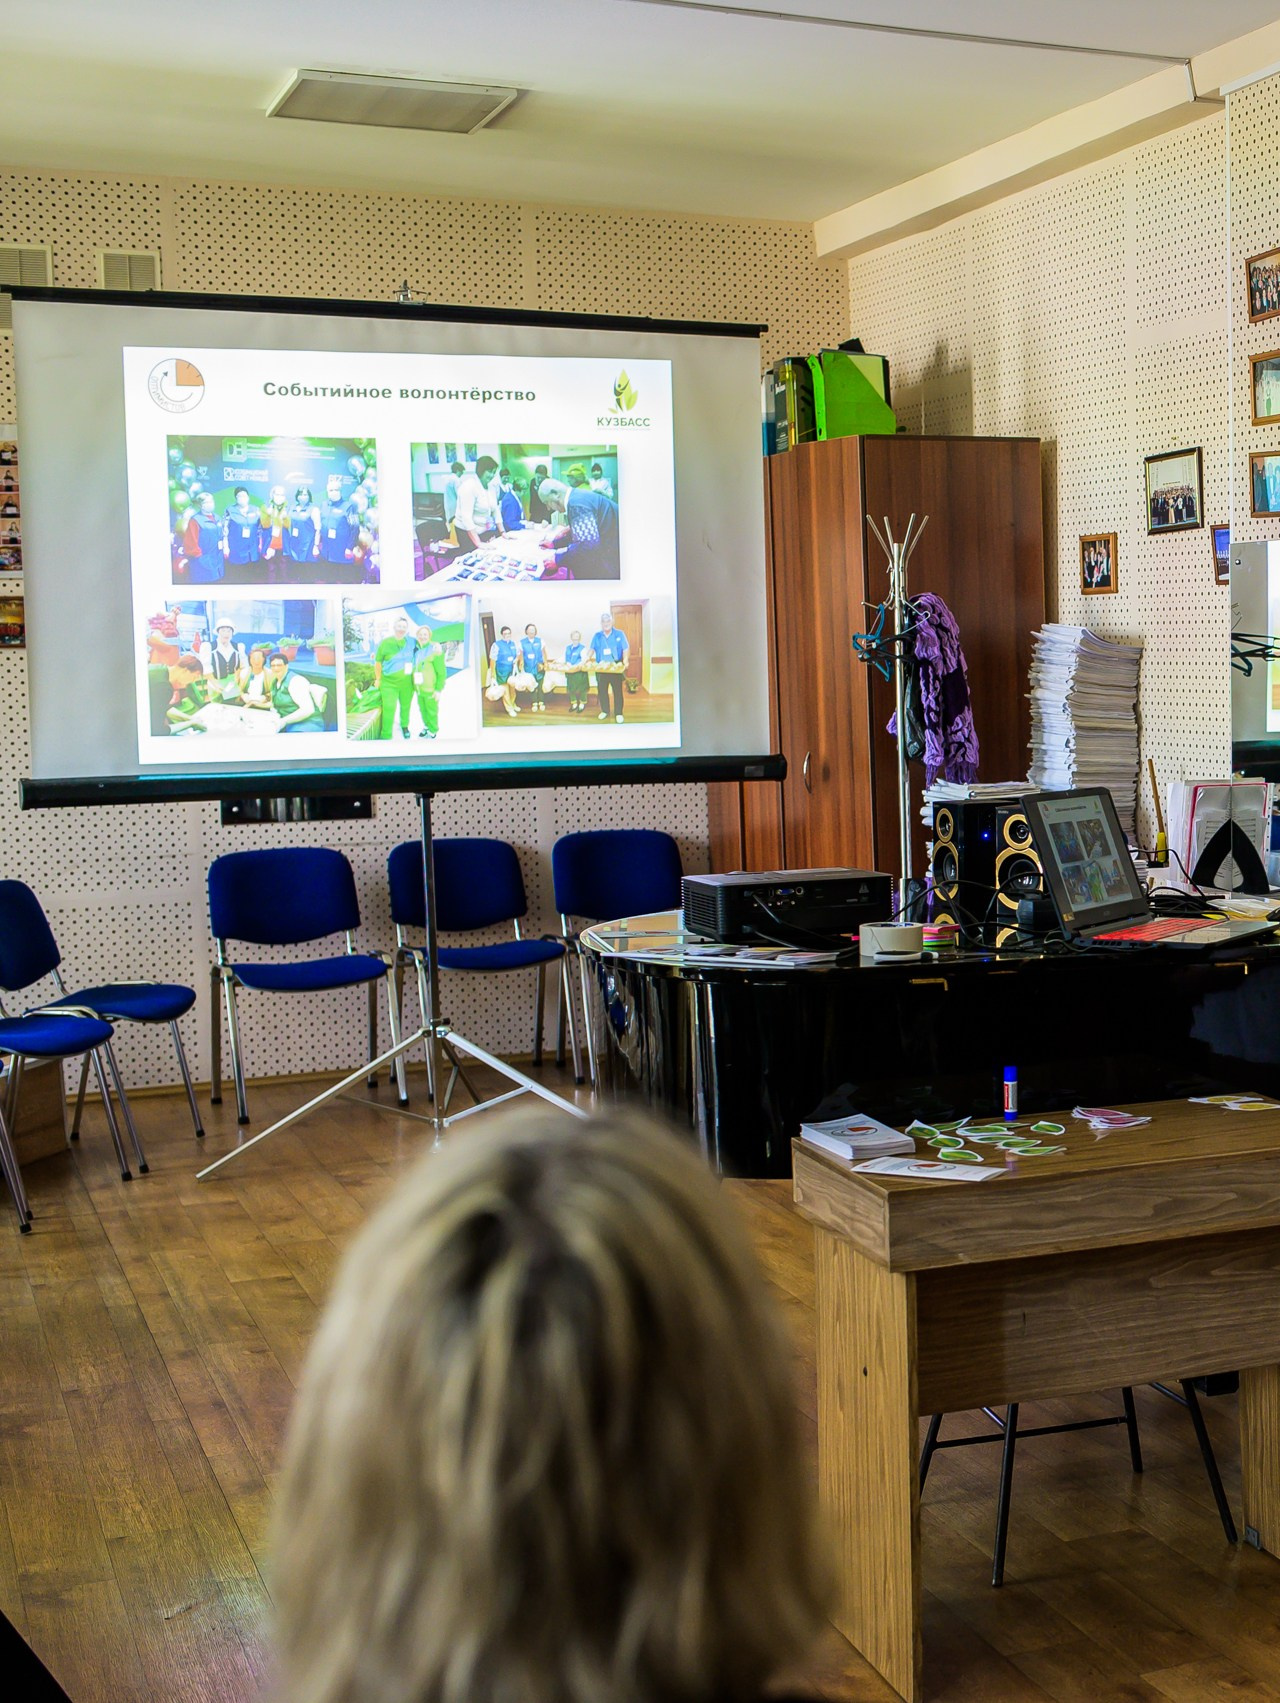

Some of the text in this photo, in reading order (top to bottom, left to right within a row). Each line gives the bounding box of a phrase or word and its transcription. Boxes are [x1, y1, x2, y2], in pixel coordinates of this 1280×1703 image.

[263, 382, 536, 403] Событийное волонтёрство
[597, 417, 650, 427] КУЗБАСС
